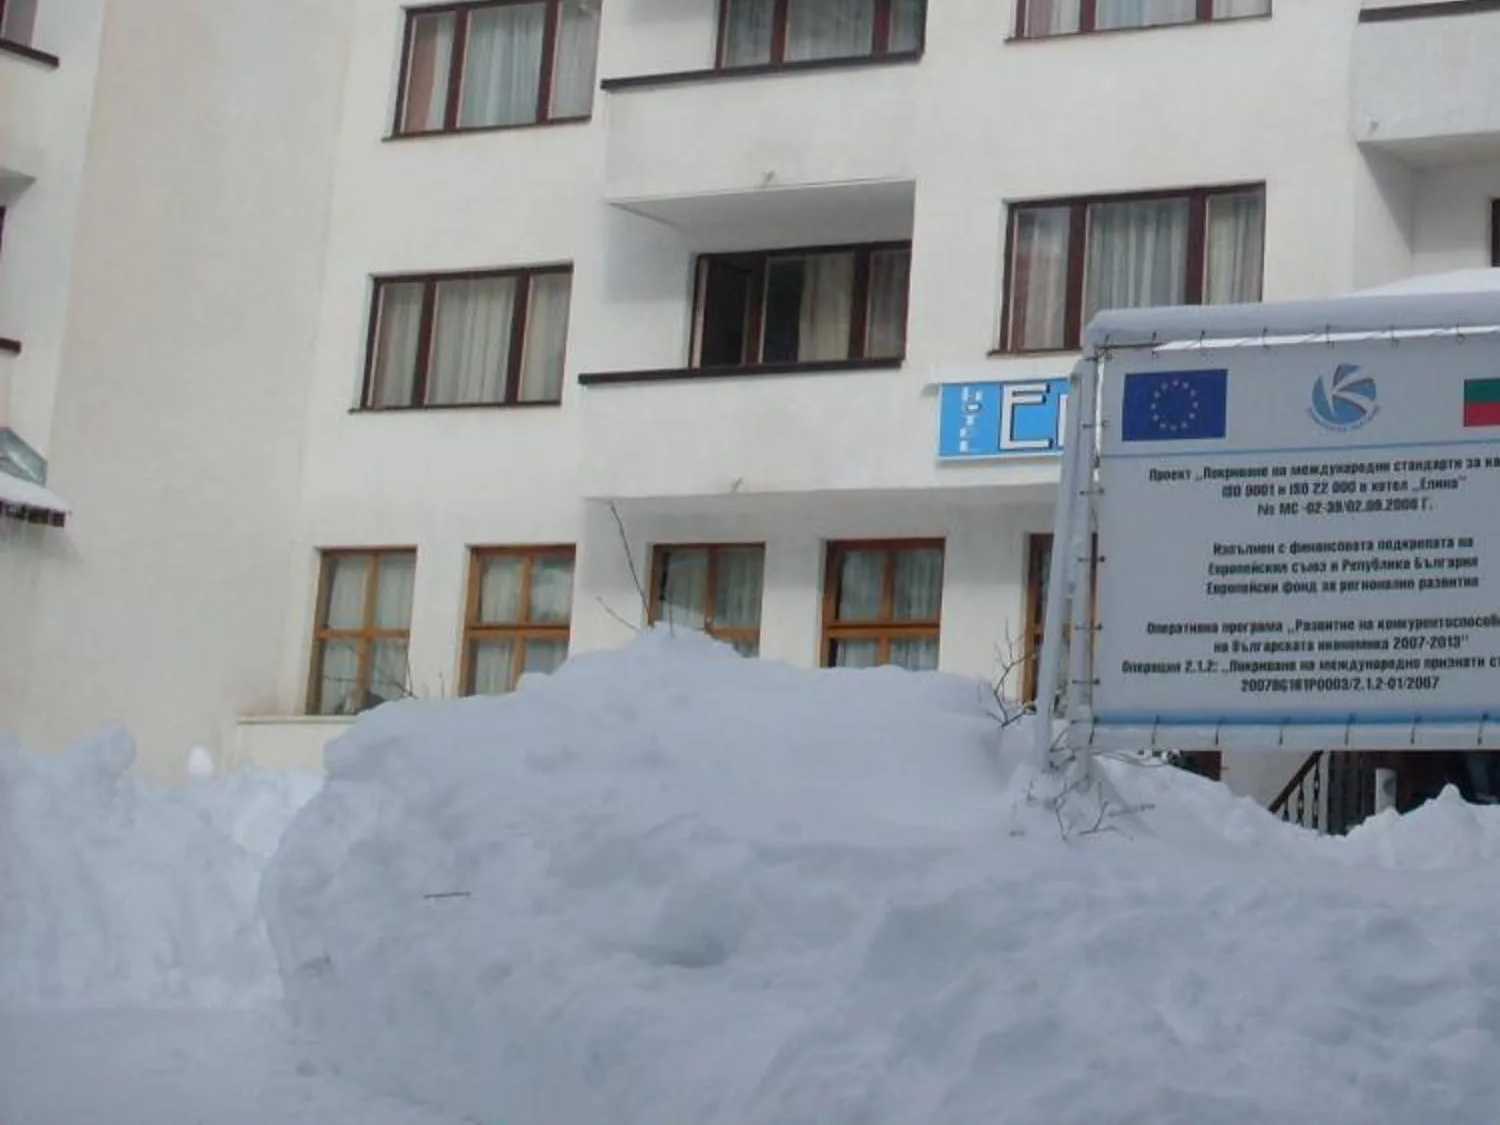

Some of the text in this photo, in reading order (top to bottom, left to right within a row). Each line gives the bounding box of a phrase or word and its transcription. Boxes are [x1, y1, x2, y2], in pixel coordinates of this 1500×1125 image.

[1149, 467, 1191, 482] Проект
[1272, 466, 1287, 477] на
[1393, 457, 1463, 472] стандарти
[1466, 457, 1481, 469] за
[1221, 484, 1241, 498] ISO
[1245, 483, 1275, 497] 9001
[1289, 482, 1309, 496] ISO
[1313, 481, 1329, 495] 22
[1332, 480, 1356, 494] 000
[1213, 542, 1274, 555] Изпълнен
[1278, 543, 1285, 554] с
[1289, 540, 1374, 555] финансовата
[1377, 538, 1455, 552] подкрепата
[1292, 561, 1326, 573] съюз
[1331, 561, 1339, 572] и
[1342, 557, 1410, 572] Република
[1413, 556, 1479, 570] България
[1206, 581, 1278, 595] Европейски
[1282, 581, 1317, 595] фонд
[1222, 620, 1283, 635] програма
[1359, 619, 1374, 631] на
[1213, 641, 1229, 653] на
[1300, 659, 1315, 672] на
[1424, 656, 1485, 671] признати
